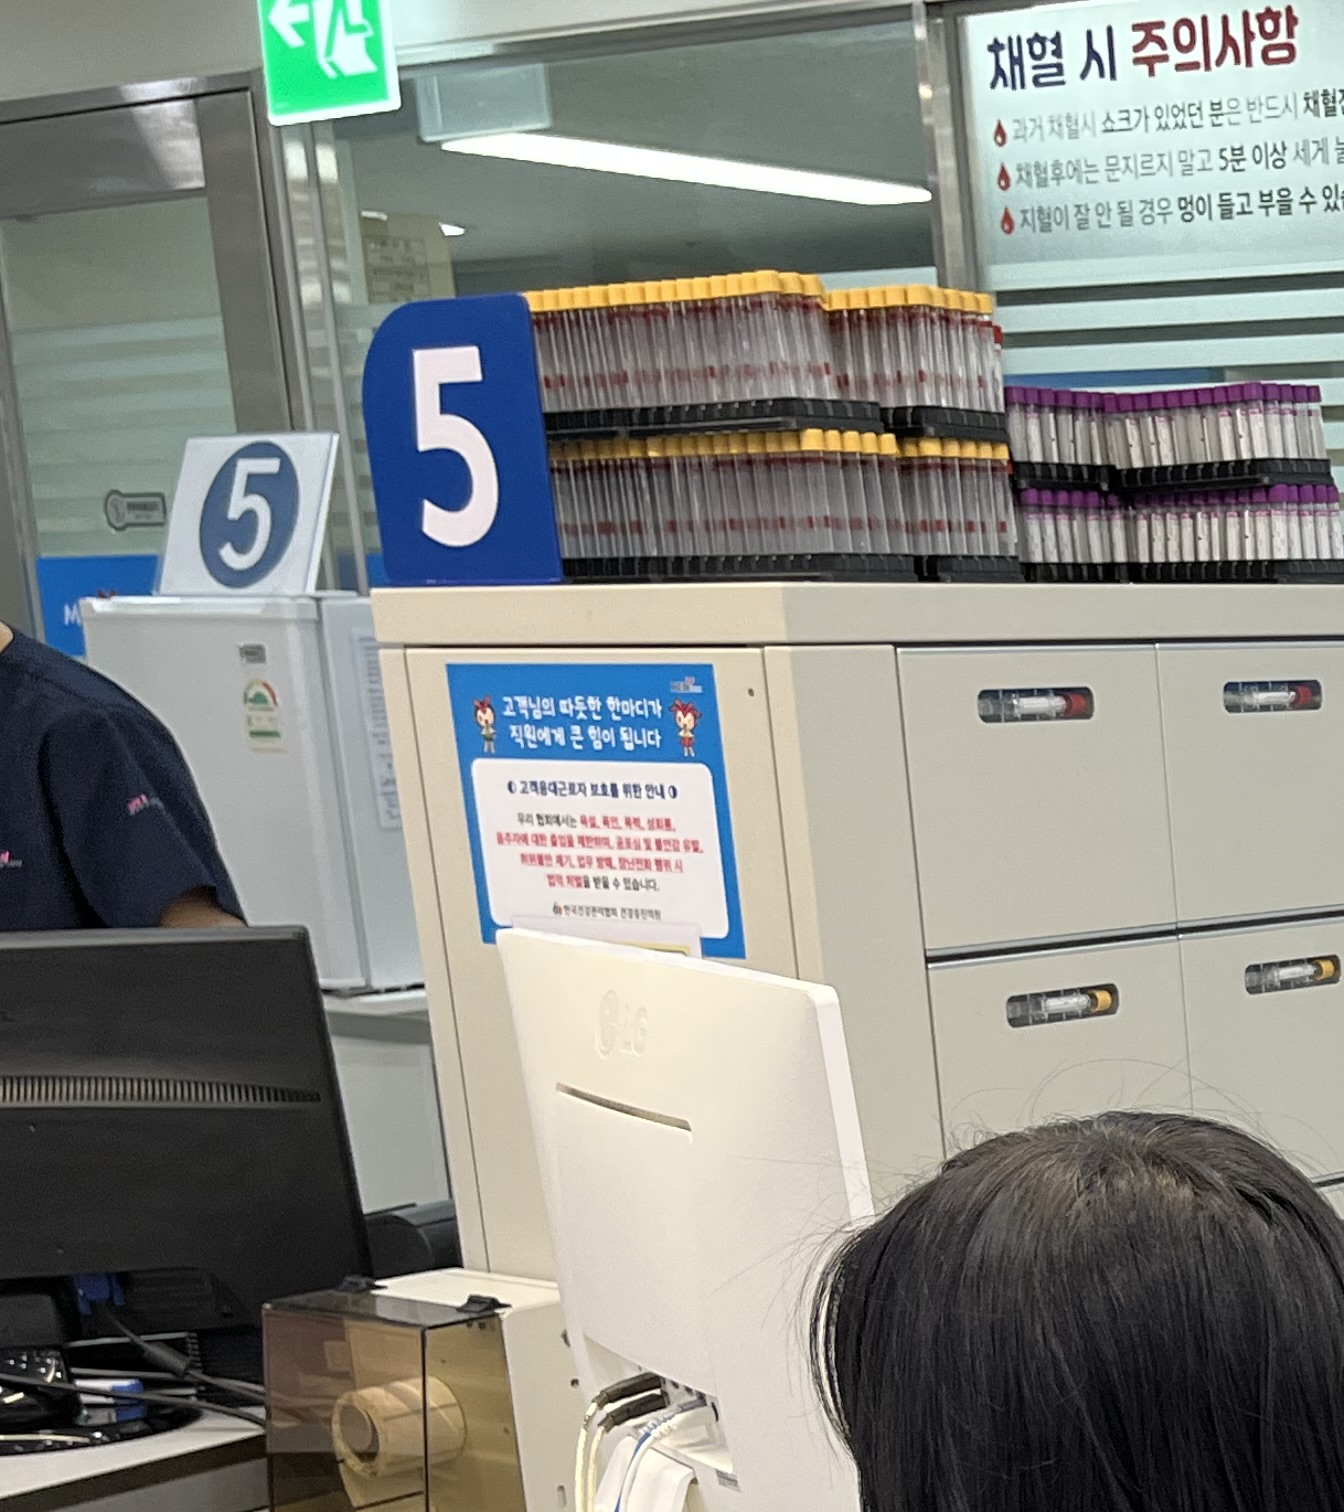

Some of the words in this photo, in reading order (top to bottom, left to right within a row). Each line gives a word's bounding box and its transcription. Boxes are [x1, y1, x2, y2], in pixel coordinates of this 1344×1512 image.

[987, 31, 1066, 90] 채혈
[1079, 24, 1117, 81] 시
[1131, 5, 1298, 78] 주의사항
[1012, 117, 1045, 143] 과거
[1154, 100, 1205, 131] 있었던
[1208, 98, 1242, 128] 분은
[1246, 92, 1299, 124] 반드시
[1015, 158, 1100, 190] 채혈후에는
[1104, 151, 1174, 184] 문지르지
[1178, 149, 1214, 177] 말고
[1218, 145, 1247, 173] 5분
[1252, 141, 1288, 170] 이상
[1292, 136, 1330, 166] 세게
[1020, 204, 1069, 235] 지혈이
[1073, 203, 1091, 231] 잘
[1095, 201, 1113, 229] 안
[1138, 196, 1174, 226] 경우
[1178, 193, 1213, 223] 멍이
[1217, 190, 1255, 221] 들고
[1257, 186, 1294, 217] 부을
[1298, 185, 1318, 215] 수
[412, 344, 499, 548] 5
[217, 457, 281, 571] 5
[502, 695, 556, 720] 고객님의
[606, 697, 662, 721] 한마디가
[510, 724, 566, 748] 직원에게
[570, 724, 584, 750] 큰
[587, 725, 615, 750] 힘이
[620, 726, 662, 751] 됩니다
